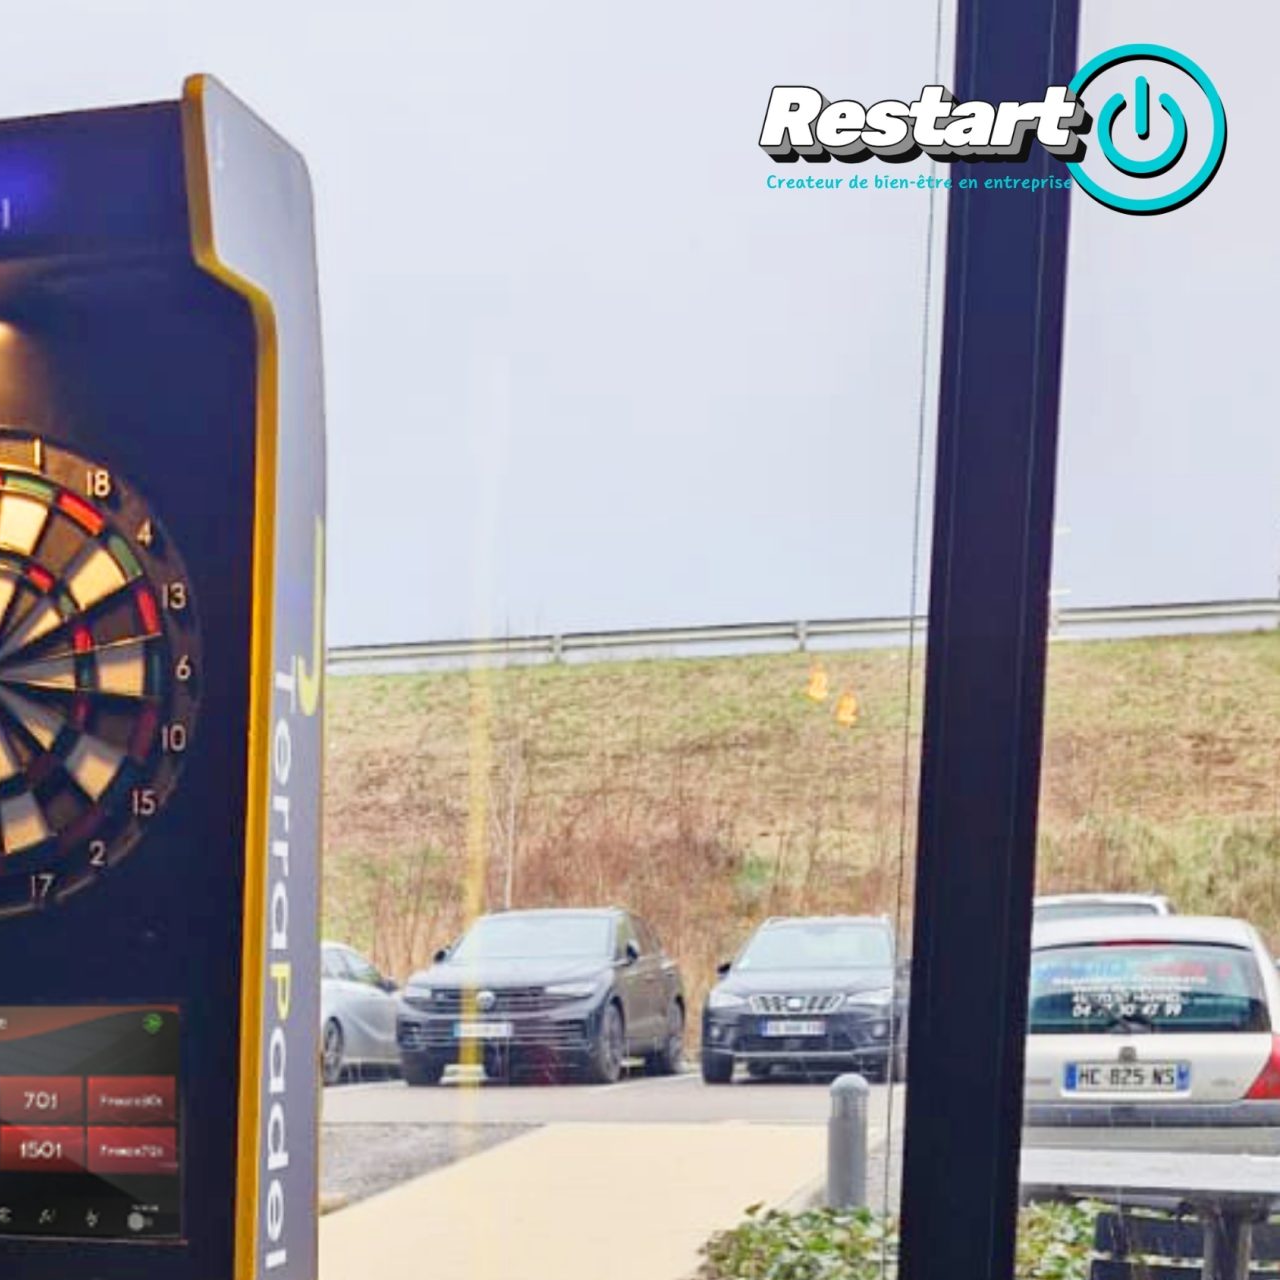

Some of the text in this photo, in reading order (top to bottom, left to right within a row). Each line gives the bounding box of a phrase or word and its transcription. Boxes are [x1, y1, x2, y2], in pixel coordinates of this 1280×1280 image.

[33, 438, 43, 464] 1
[86, 470, 111, 497] 18
[136, 521, 153, 546] 4
[163, 583, 187, 610] 13
[176, 656, 192, 681] 6
[161, 724, 187, 752] 10
[131, 789, 157, 816] 15
[88, 840, 106, 867] 2
[30, 874, 54, 899] 17
[264, 652, 298, 1270] TerraPadel
[24, 1091, 58, 1110] 701
[20, 1140, 62, 1159] 1501
